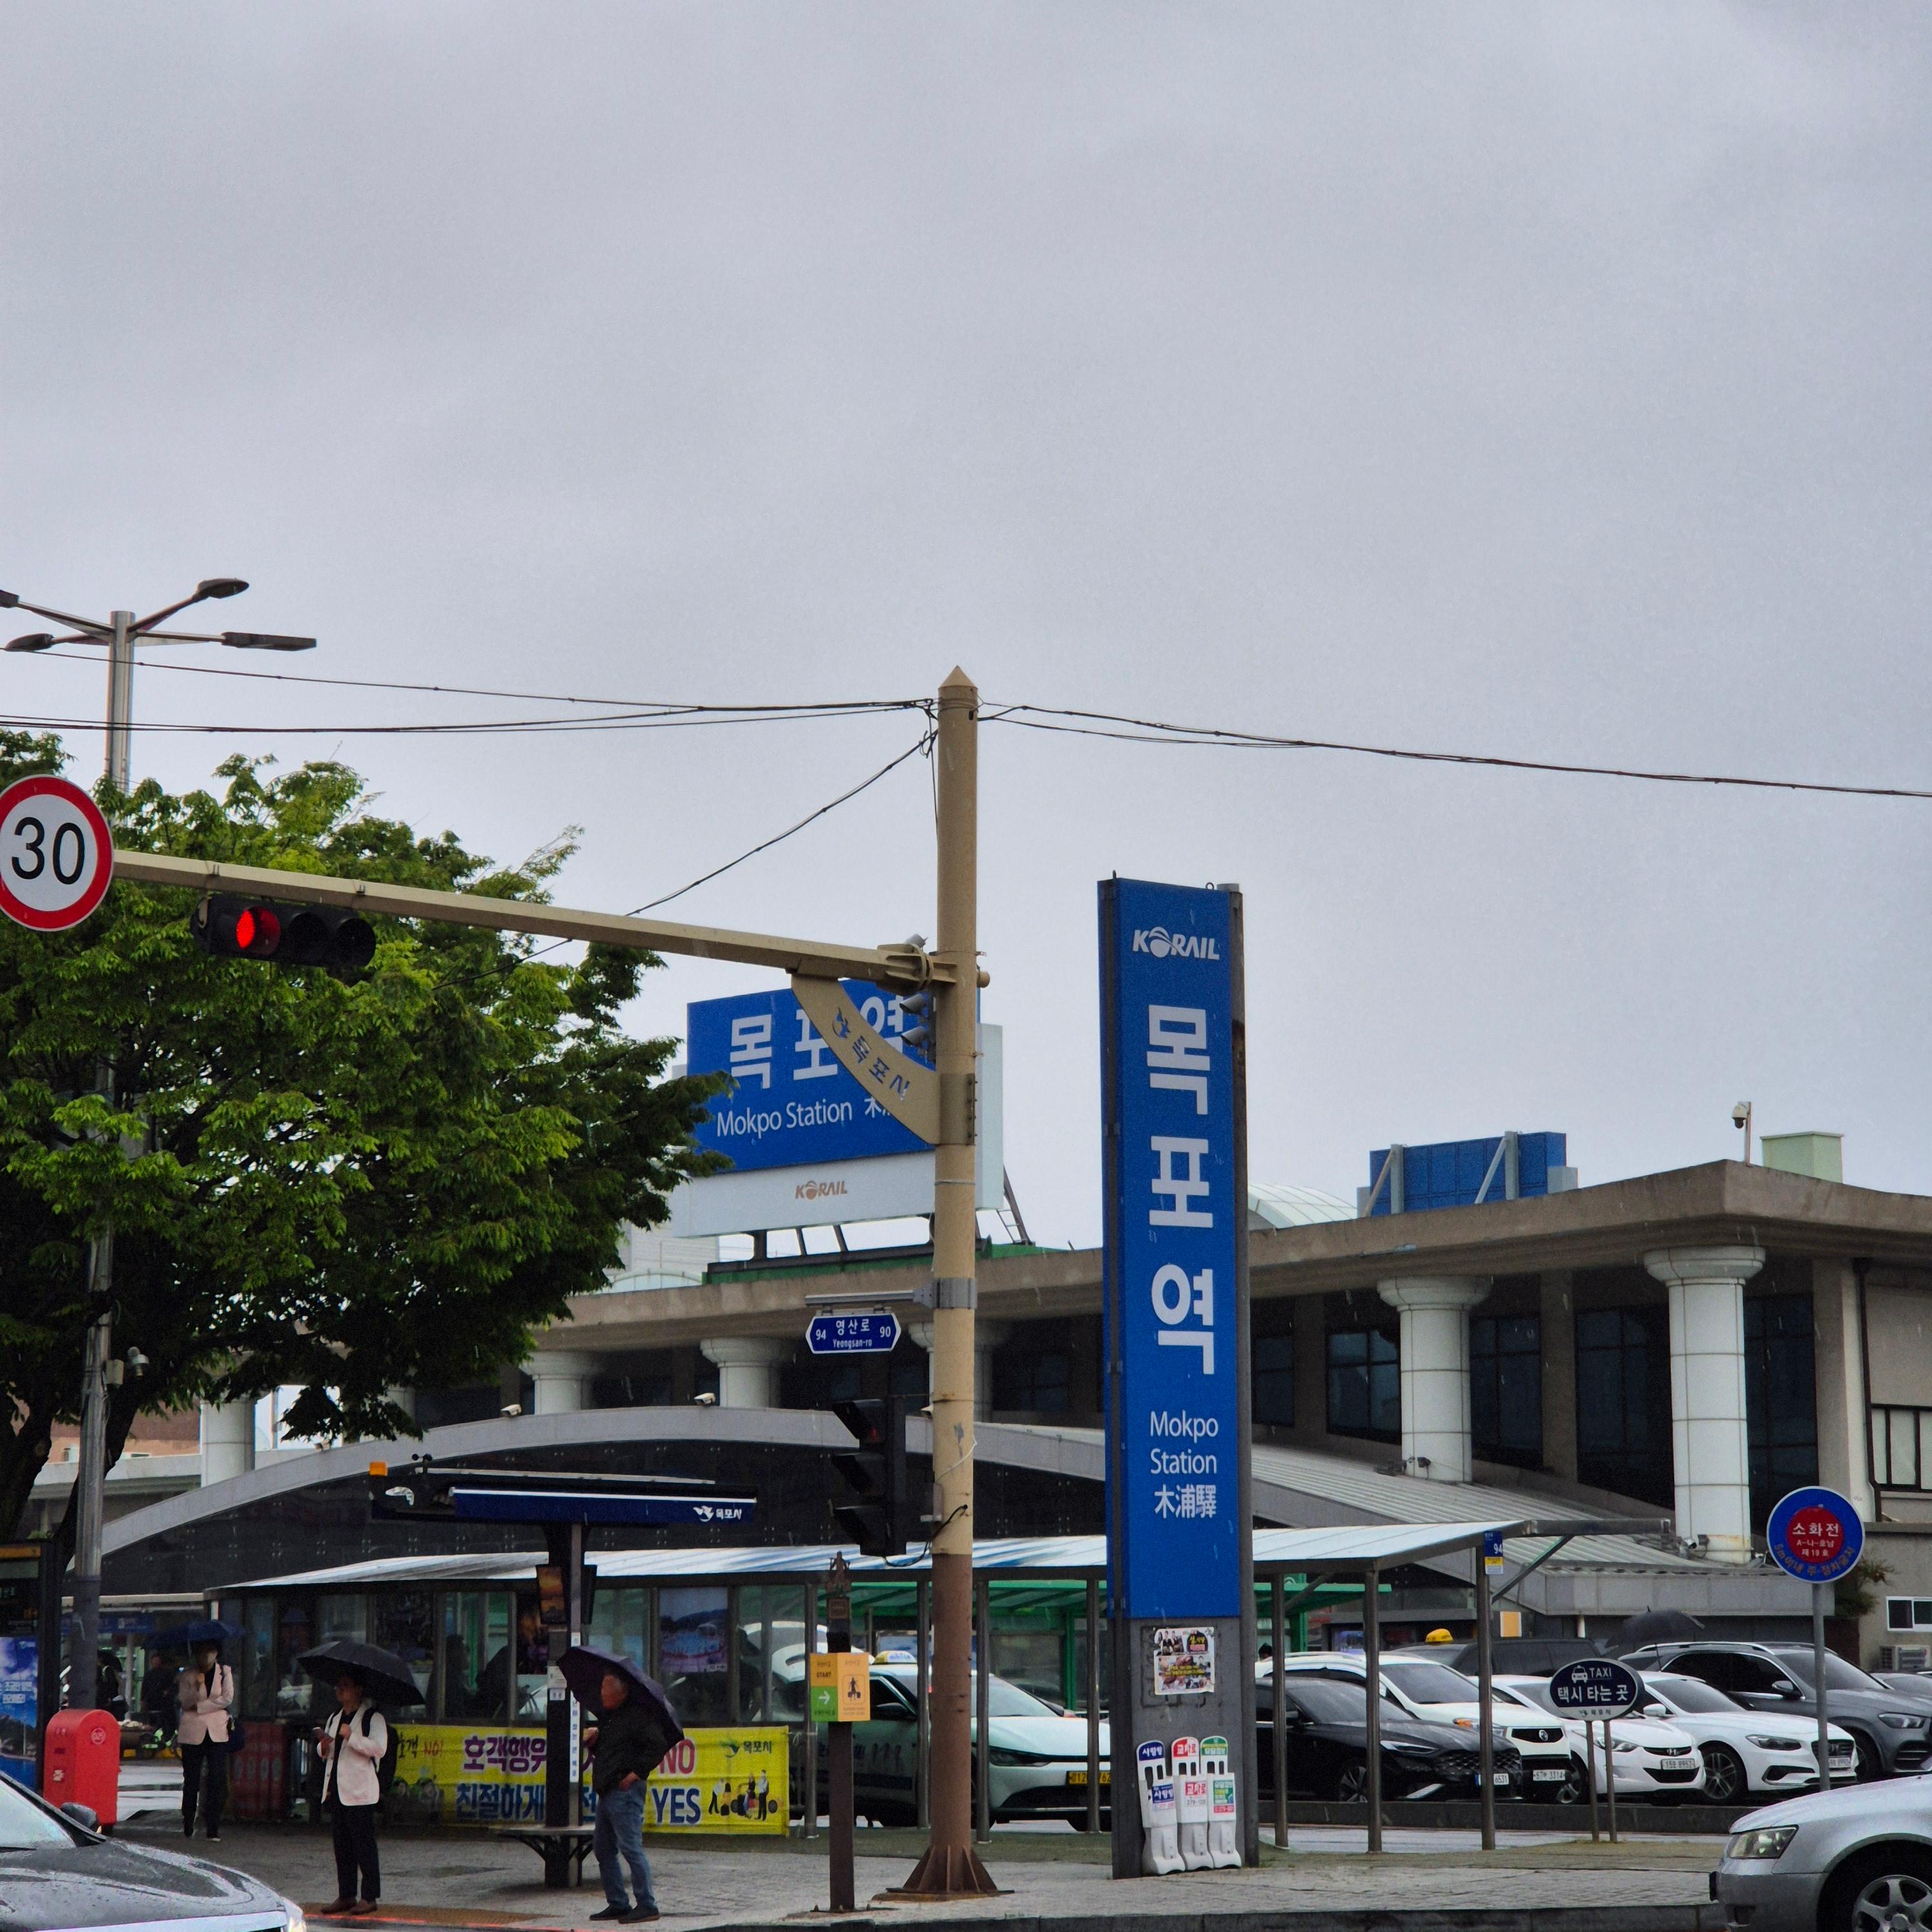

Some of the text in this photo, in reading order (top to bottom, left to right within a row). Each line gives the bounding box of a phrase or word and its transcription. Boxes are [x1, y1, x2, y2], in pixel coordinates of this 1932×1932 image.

[11, 816, 85, 885] 30
[1132, 926, 1220, 960] KORAIL
[851, 1036, 910, 1102] 목포시
[717, 1106, 782, 1138] Mokpo
[786, 1098, 852, 1129] Station
[795, 1180, 847, 1200] KORAIL
[1147, 1004, 1215, 1375] 목포역
[816, 1319, 891, 1340] 94 영산로 90
[833, 1339, 872, 1350] Yeongsan-ro
[1150, 1409, 1218, 1443] Mokpo
[1151, 1448, 1217, 1475] Station
[1155, 1483, 1217, 1519] 木浦驛
[716, 1508, 742, 1519] 목포시
[1793, 1523, 1839, 1537] 소화전
[1494, 1543, 1502, 1554] 94
[1589, 1667, 1612, 1678] TAXI
[1557, 1685, 1629, 1703] 택시 타는 곳
[424, 1740, 444, 1756] NO!
[659, 1738, 695, 1774] NO
[743, 1740, 772, 1754] 목포시
[1495, 1775, 1508, 1783] 6531
[652, 1787, 701, 1825] YES
